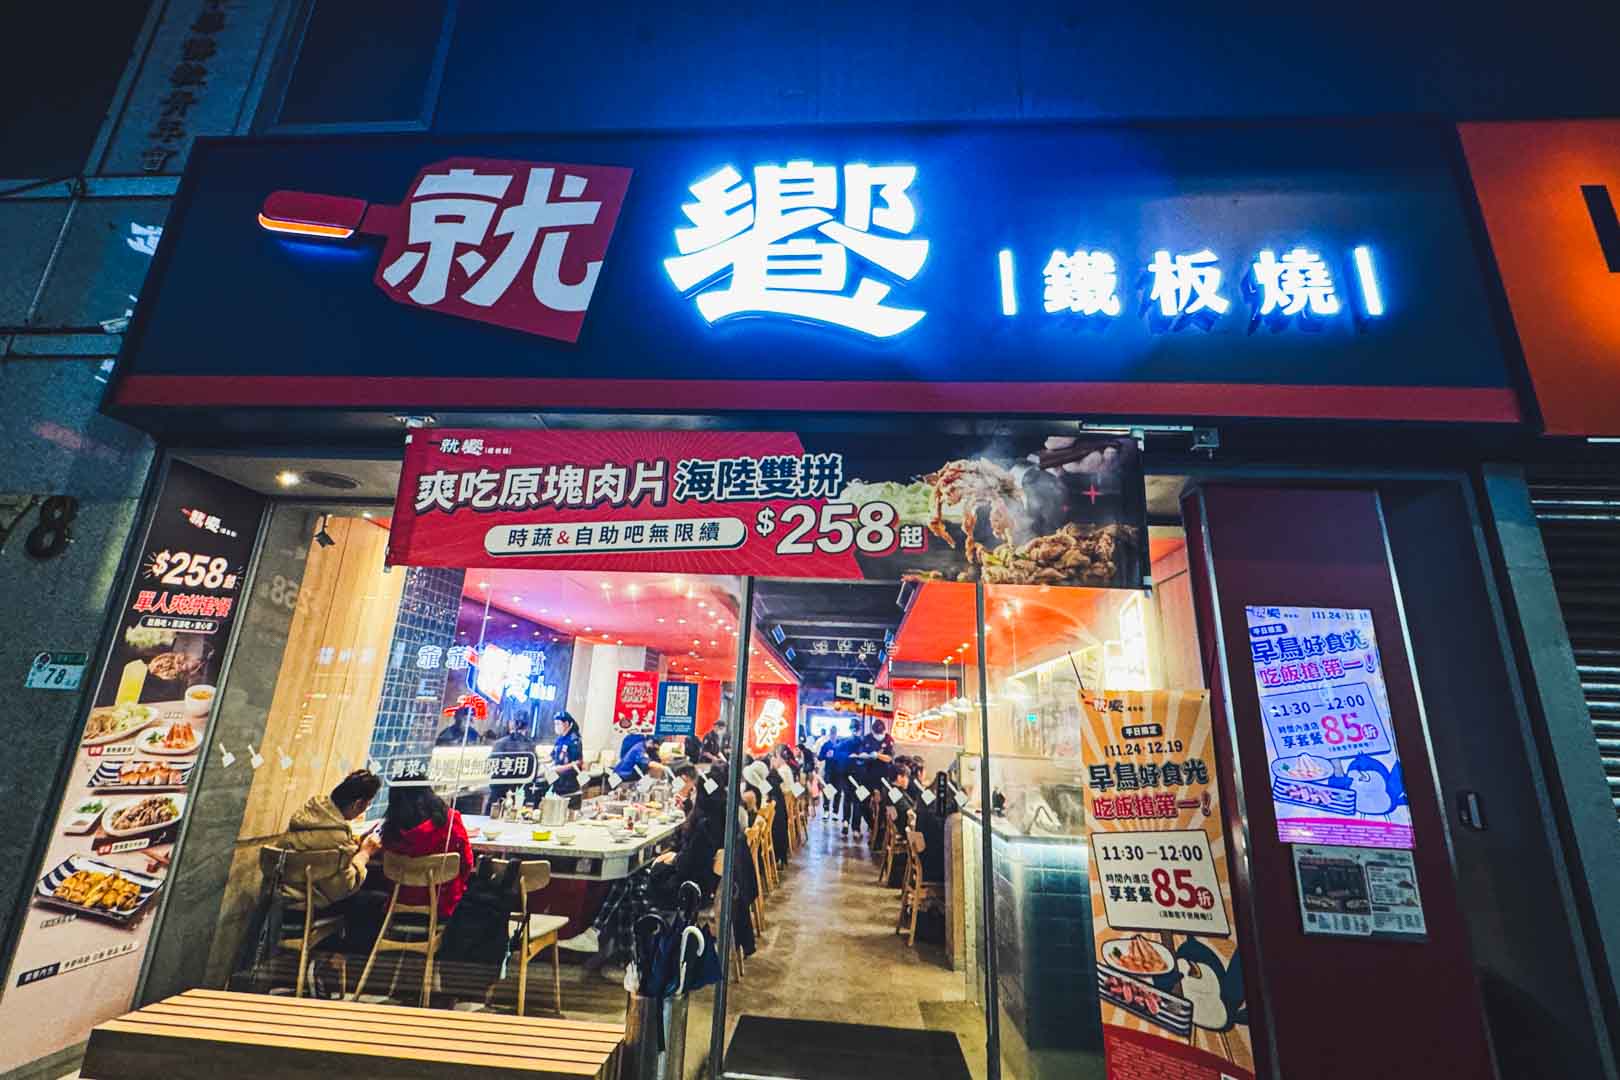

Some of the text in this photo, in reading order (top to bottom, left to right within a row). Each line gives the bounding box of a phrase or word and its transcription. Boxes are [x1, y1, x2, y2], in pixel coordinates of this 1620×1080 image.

[1043, 248, 1339, 316] 鐵板燒
[415, 454, 843, 510] 爽吃原塊肉片 海陸雙拼
[506, 522, 721, 547] 時蔬&自助吧無限續
[1252, 630, 1369, 664] 早鳥好食光
[1089, 758, 1209, 793] 早鳥好食光
